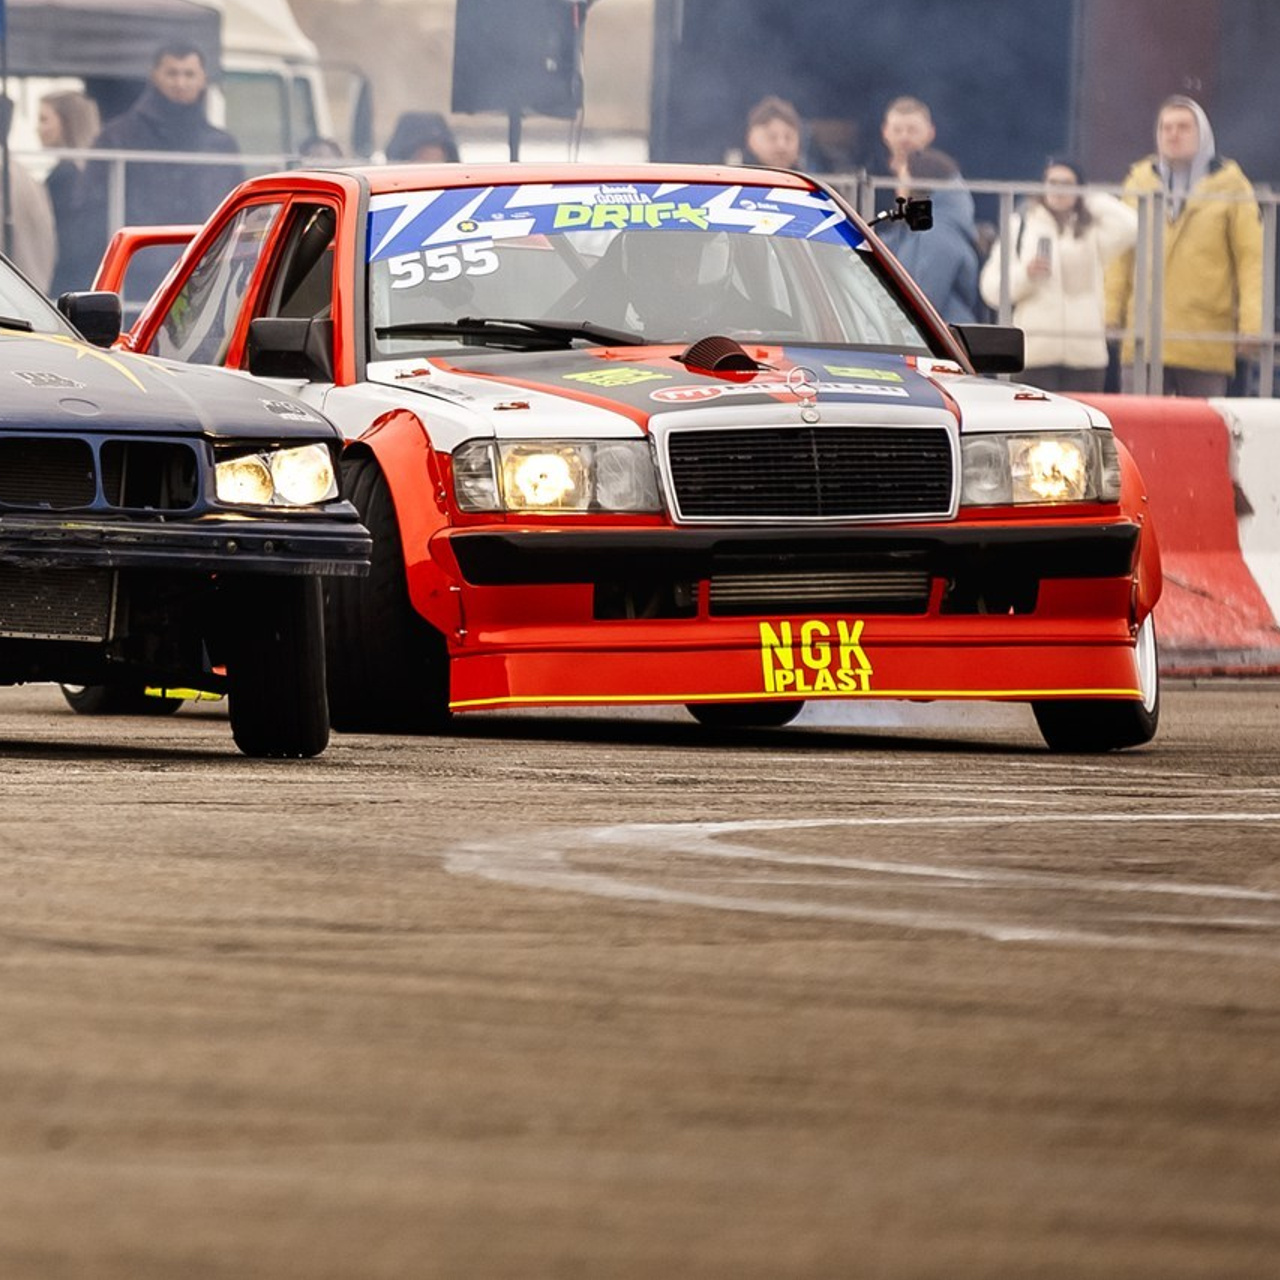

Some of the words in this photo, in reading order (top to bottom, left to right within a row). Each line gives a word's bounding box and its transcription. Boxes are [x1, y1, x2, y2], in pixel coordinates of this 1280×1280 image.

[553, 201, 708, 231] DRIFT
[387, 239, 500, 289] 555
[759, 620, 872, 692] NGK
[774, 668, 873, 692] PLAST
